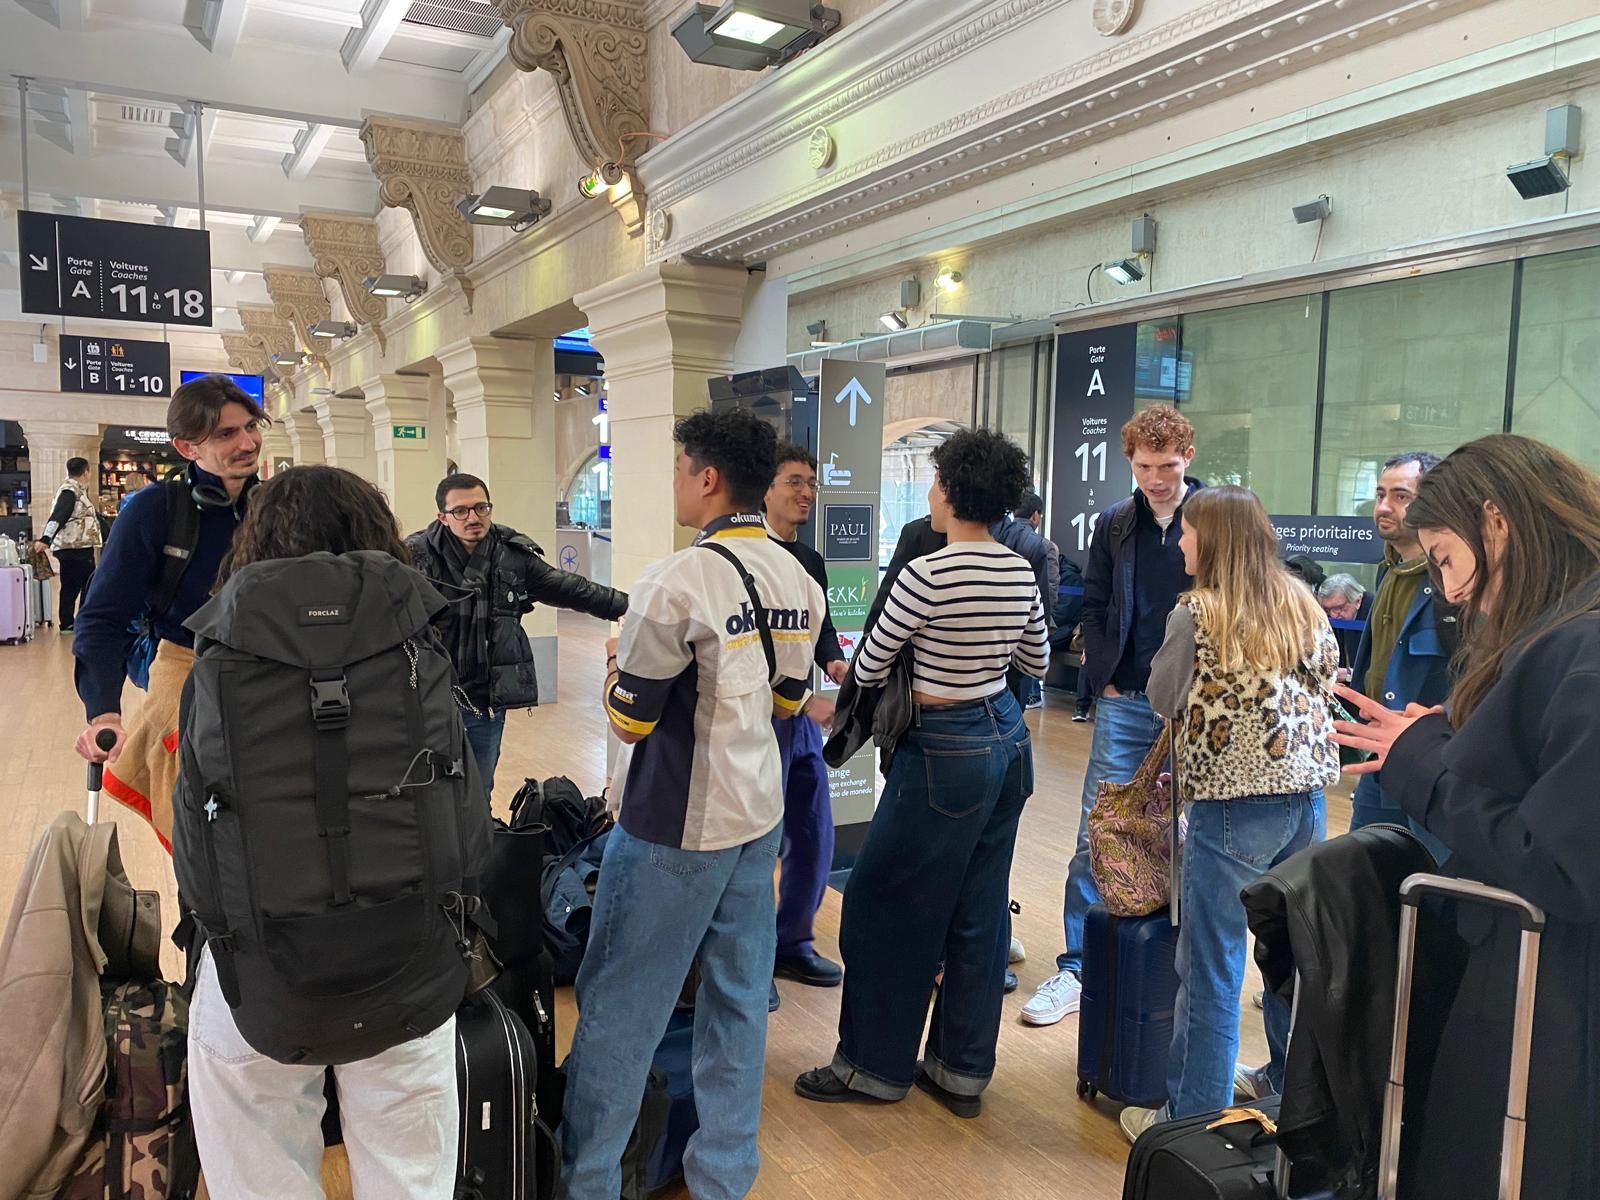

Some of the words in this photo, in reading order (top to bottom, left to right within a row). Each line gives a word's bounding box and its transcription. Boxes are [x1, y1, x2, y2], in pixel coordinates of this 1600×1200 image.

[67, 257, 93, 267] Porte
[110, 261, 149, 272] Voitures
[70, 266, 92, 276] Gate
[112, 270, 148, 281] Coaches
[72, 280, 91, 299] A
[110, 284, 147, 314] 11
[164, 288, 205, 318] 18
[152, 302, 161, 310] to
[1089, 345, 1106, 355] Porte
[86, 359, 101, 367] Porte
[1090, 355, 1105, 364] Gate
[110, 361, 134, 369] Voitures
[90, 372, 100, 384] B
[1086, 368, 1105, 397] A
[114, 374, 126, 392] 1
[139, 375, 164, 393] 10
[1082, 417, 1108, 427] Voitures
[1082, 427, 1107, 436] Coaches
[1075, 442, 1107, 482] 11
[1088, 498, 1095, 506] to
[730, 511, 763, 524] okuma
[830, 523, 868, 536] PAUL
[1300, 524, 1373, 541] prioritaires
[1286, 543, 1311, 554] Priority
[1312, 545, 1339, 556] seating
[840, 779, 867, 787] exchange
[850, 787, 873, 796] moneda
